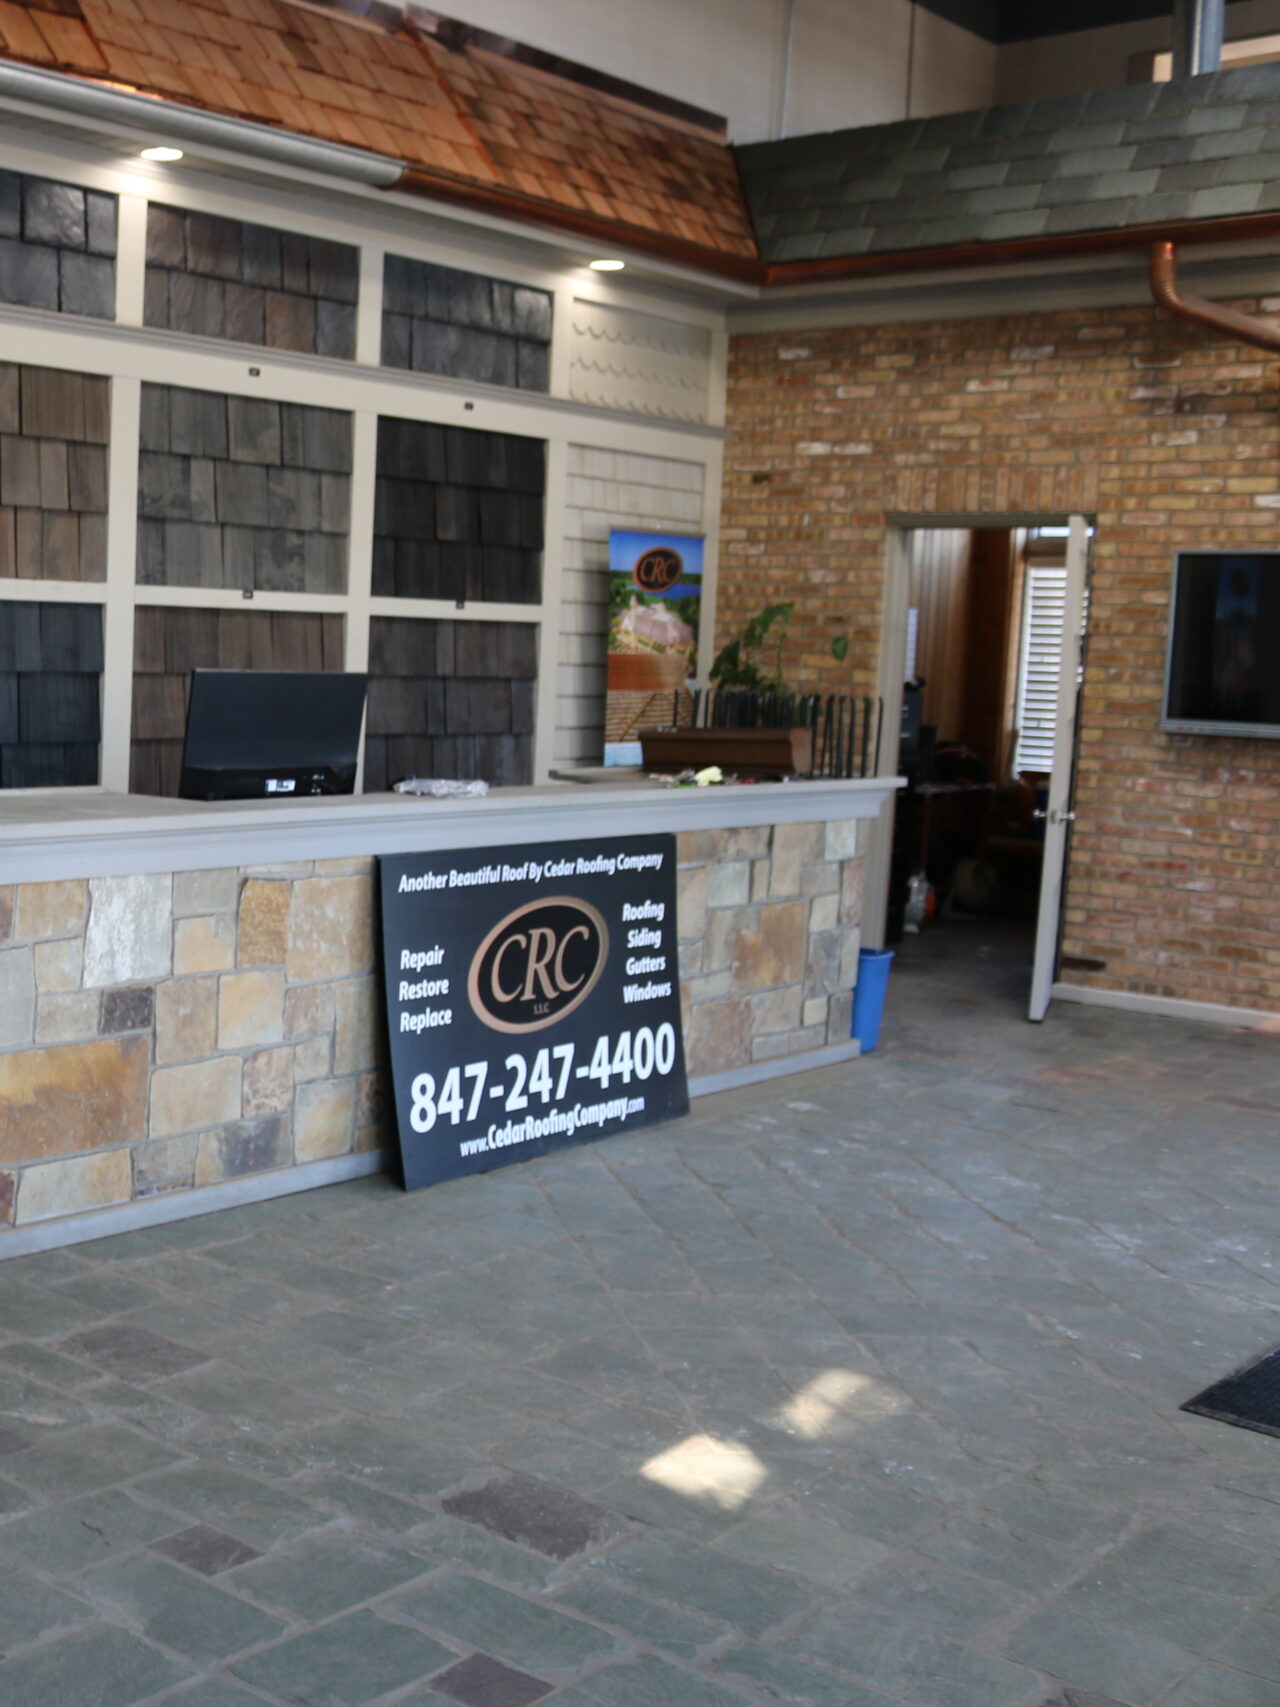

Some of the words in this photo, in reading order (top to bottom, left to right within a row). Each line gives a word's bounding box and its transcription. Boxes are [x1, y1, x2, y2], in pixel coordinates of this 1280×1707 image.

[640, 557, 677, 583] CRC
[398, 872, 448, 893] Another
[449, 864, 501, 887] Beautiful
[502, 864, 528, 881] Roof
[529, 863, 543, 882] By
[544, 860, 576, 878] Cedar
[576, 857, 616, 876] Roofing
[617, 852, 664, 871] Company
[622, 899, 666, 922] Roofing
[627, 927, 662, 949] Siding
[400, 945, 445, 971] Repair
[491, 925, 590, 1003] CRC
[625, 955, 666, 976] Gutters
[399, 977, 449, 1001] Restore
[623, 981, 672, 1004] Windows
[400, 1007, 452, 1034] Replace
[533, 1003, 551, 1015] LLC
[409, 1022, 676, 1134] 847-247-4400
[460, 1096, 645, 1157] www.CedarRoofingCompany.com
